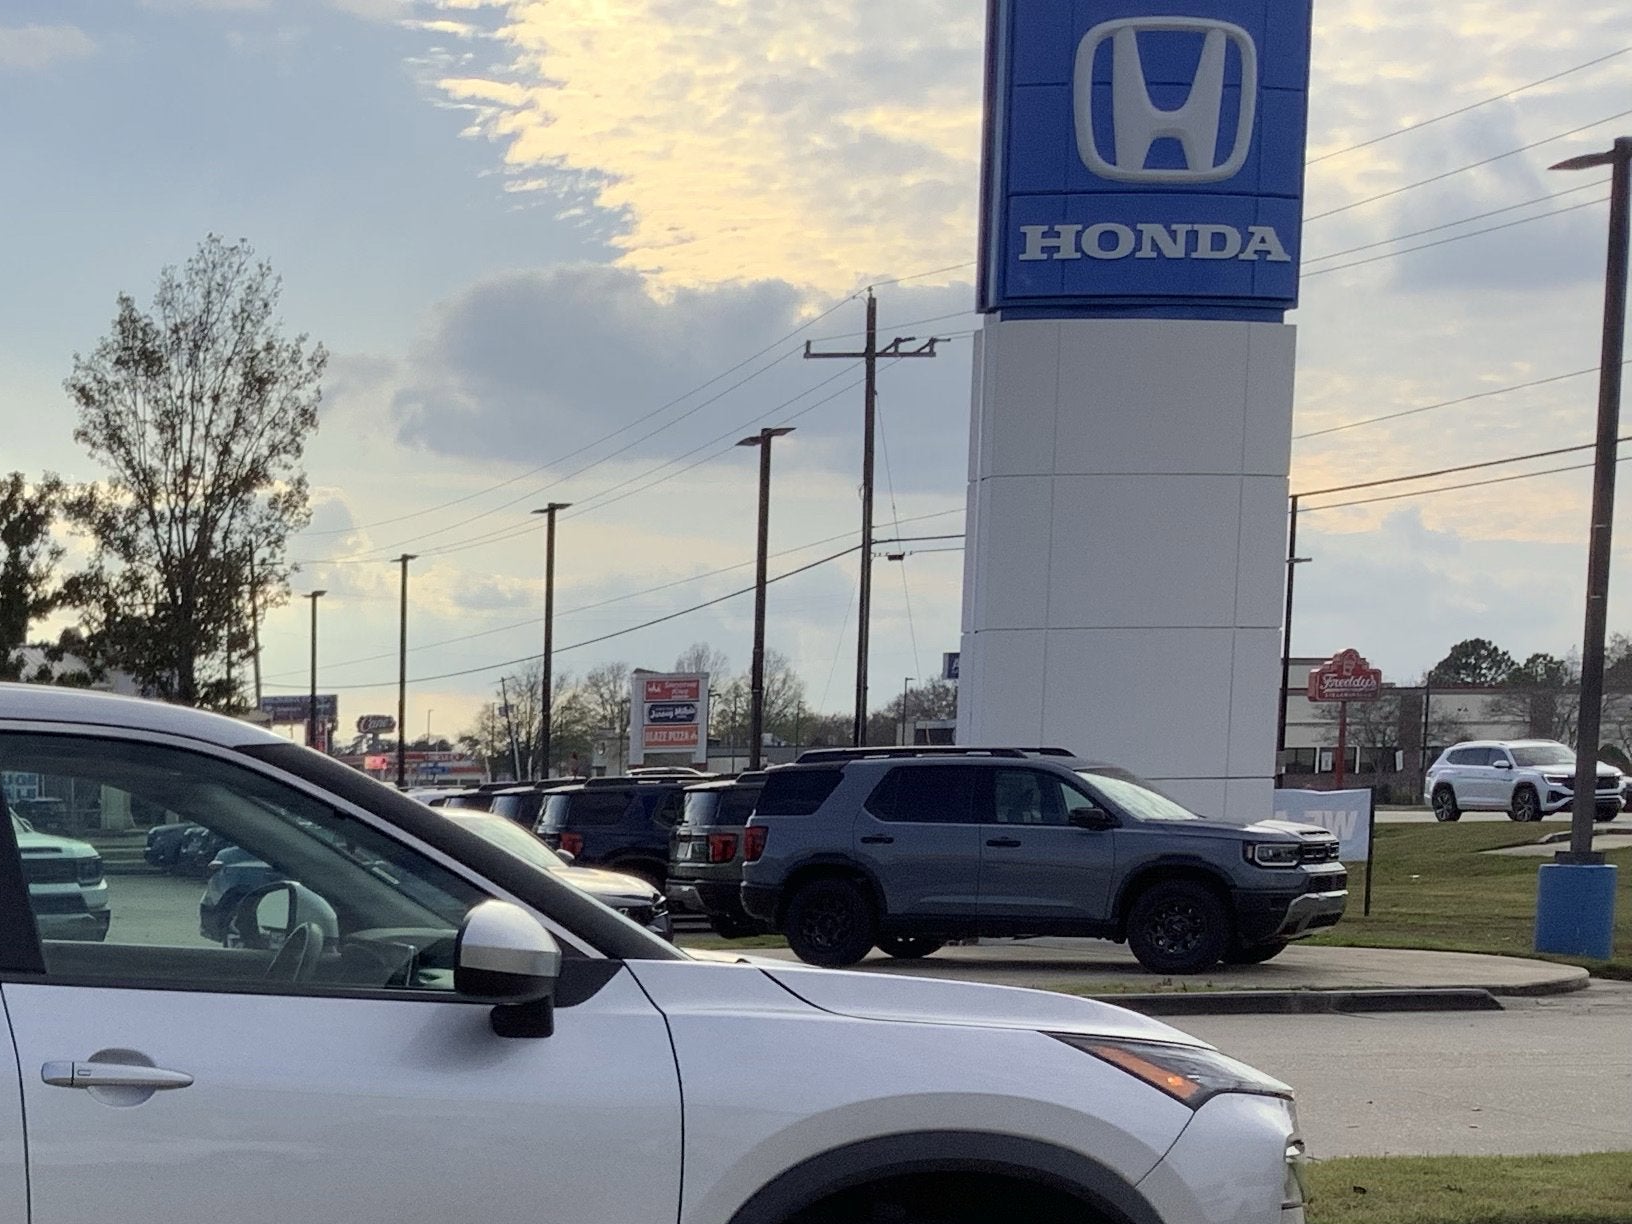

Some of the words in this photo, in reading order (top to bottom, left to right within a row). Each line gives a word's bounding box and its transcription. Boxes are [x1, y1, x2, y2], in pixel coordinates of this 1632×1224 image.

[1019, 222, 1292, 262] HONDA
[1320, 673, 1377, 690] Freddy's
[668, 730, 689, 742] PIZZA
